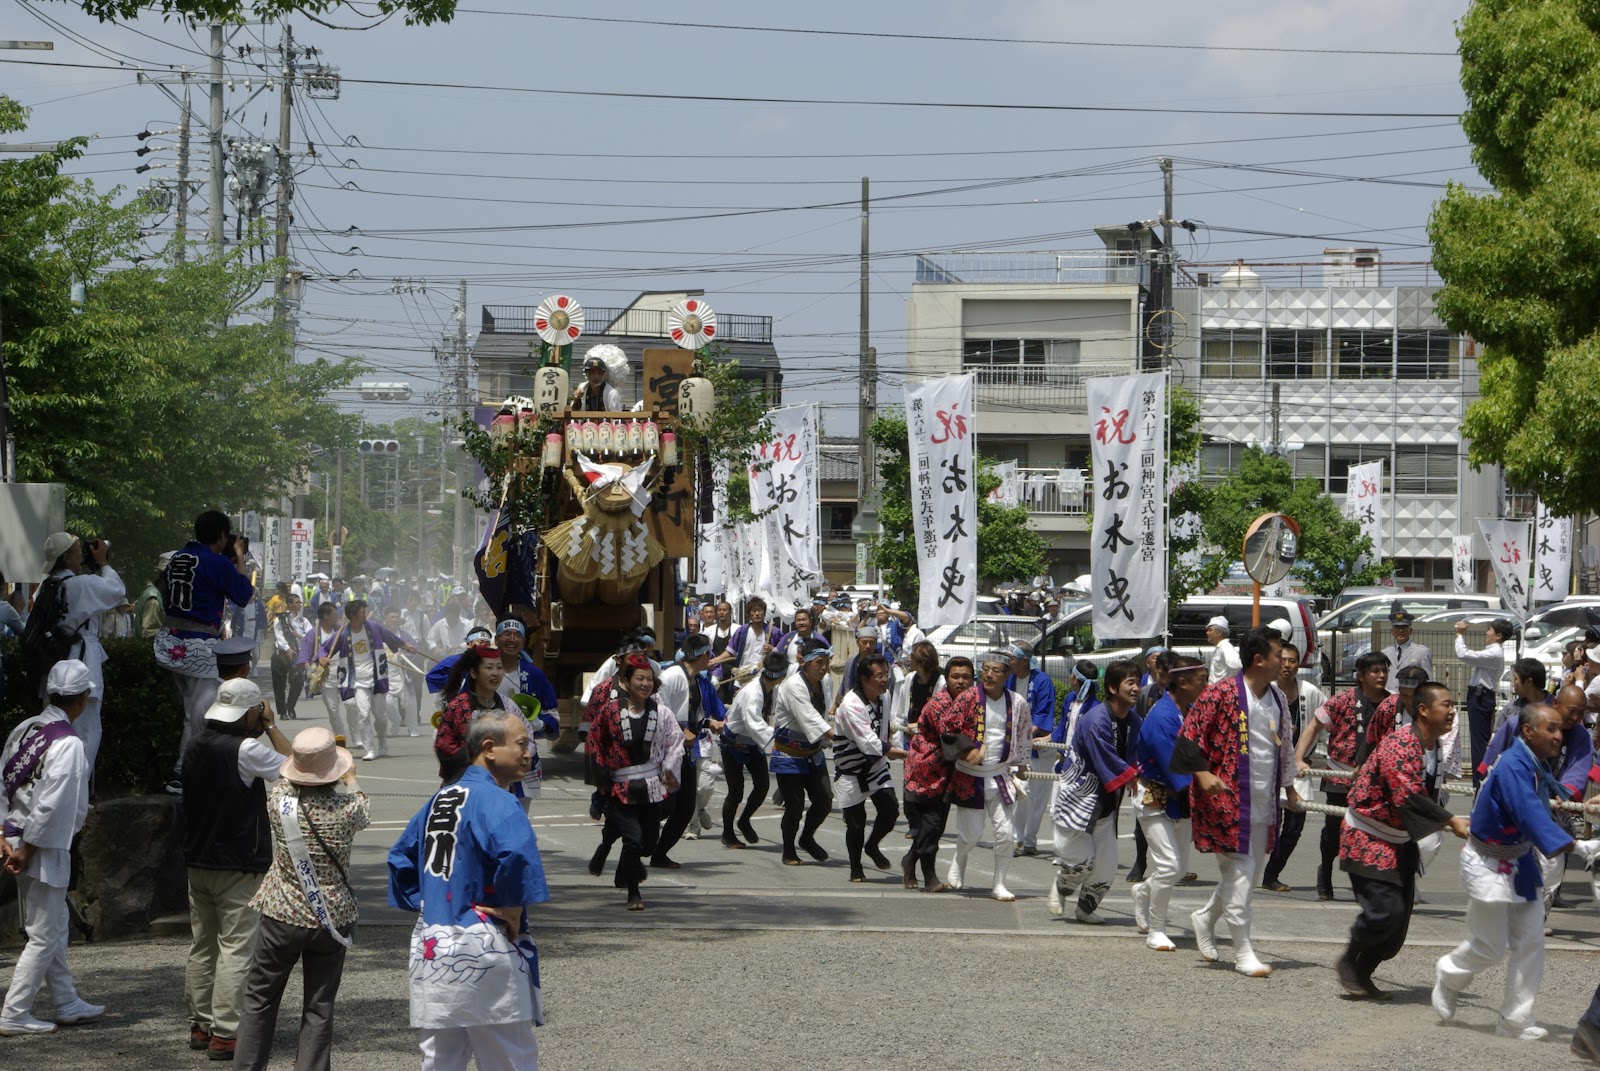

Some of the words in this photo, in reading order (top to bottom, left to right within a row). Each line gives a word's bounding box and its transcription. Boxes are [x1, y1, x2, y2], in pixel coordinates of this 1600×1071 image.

[649, 365, 690, 527] 宮町
[1140, 390, 1157, 563] 第六十二回神宮式年遷宮
[167, 554, 199, 611] 宮川
[294, 542, 303, 580] 厚生小学校
[424, 786, 469, 880] 宮川
